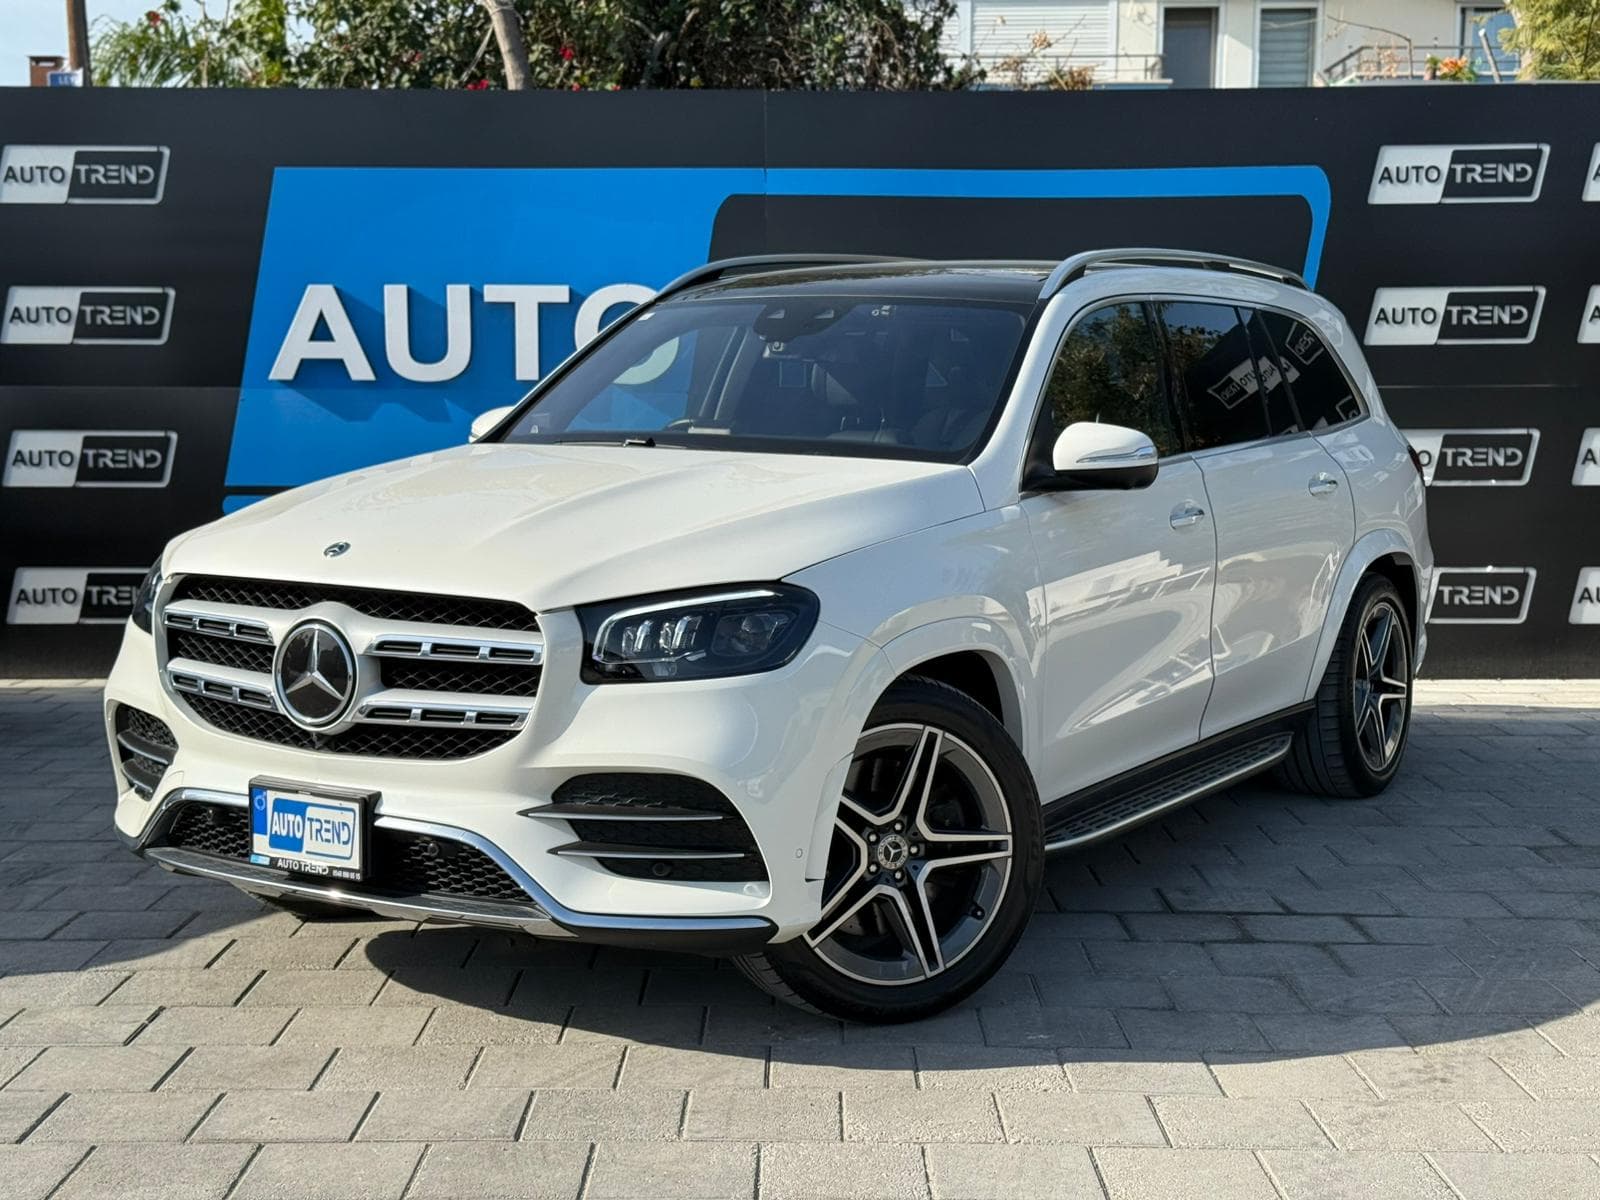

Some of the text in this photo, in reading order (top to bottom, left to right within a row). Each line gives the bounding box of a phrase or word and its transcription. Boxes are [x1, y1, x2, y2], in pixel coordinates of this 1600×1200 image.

[3, 164, 155, 184] AUTO TREND
[1378, 163, 1533, 184] AUTO TREND
[9, 305, 160, 325] AUTO TREND
[1374, 305, 1528, 325] AUTO TREND
[268, 283, 680, 385] AUTO
[12, 449, 162, 468] AUTO TREND
[1442, 447, 1523, 467] TREND
[16, 586, 139, 606] AUTO TRE
[1438, 585, 1520, 605] TREND
[271, 811, 351, 846] AUTO TREND
[277, 858, 300, 870] AUTO
[300, 861, 329, 875] TREND
